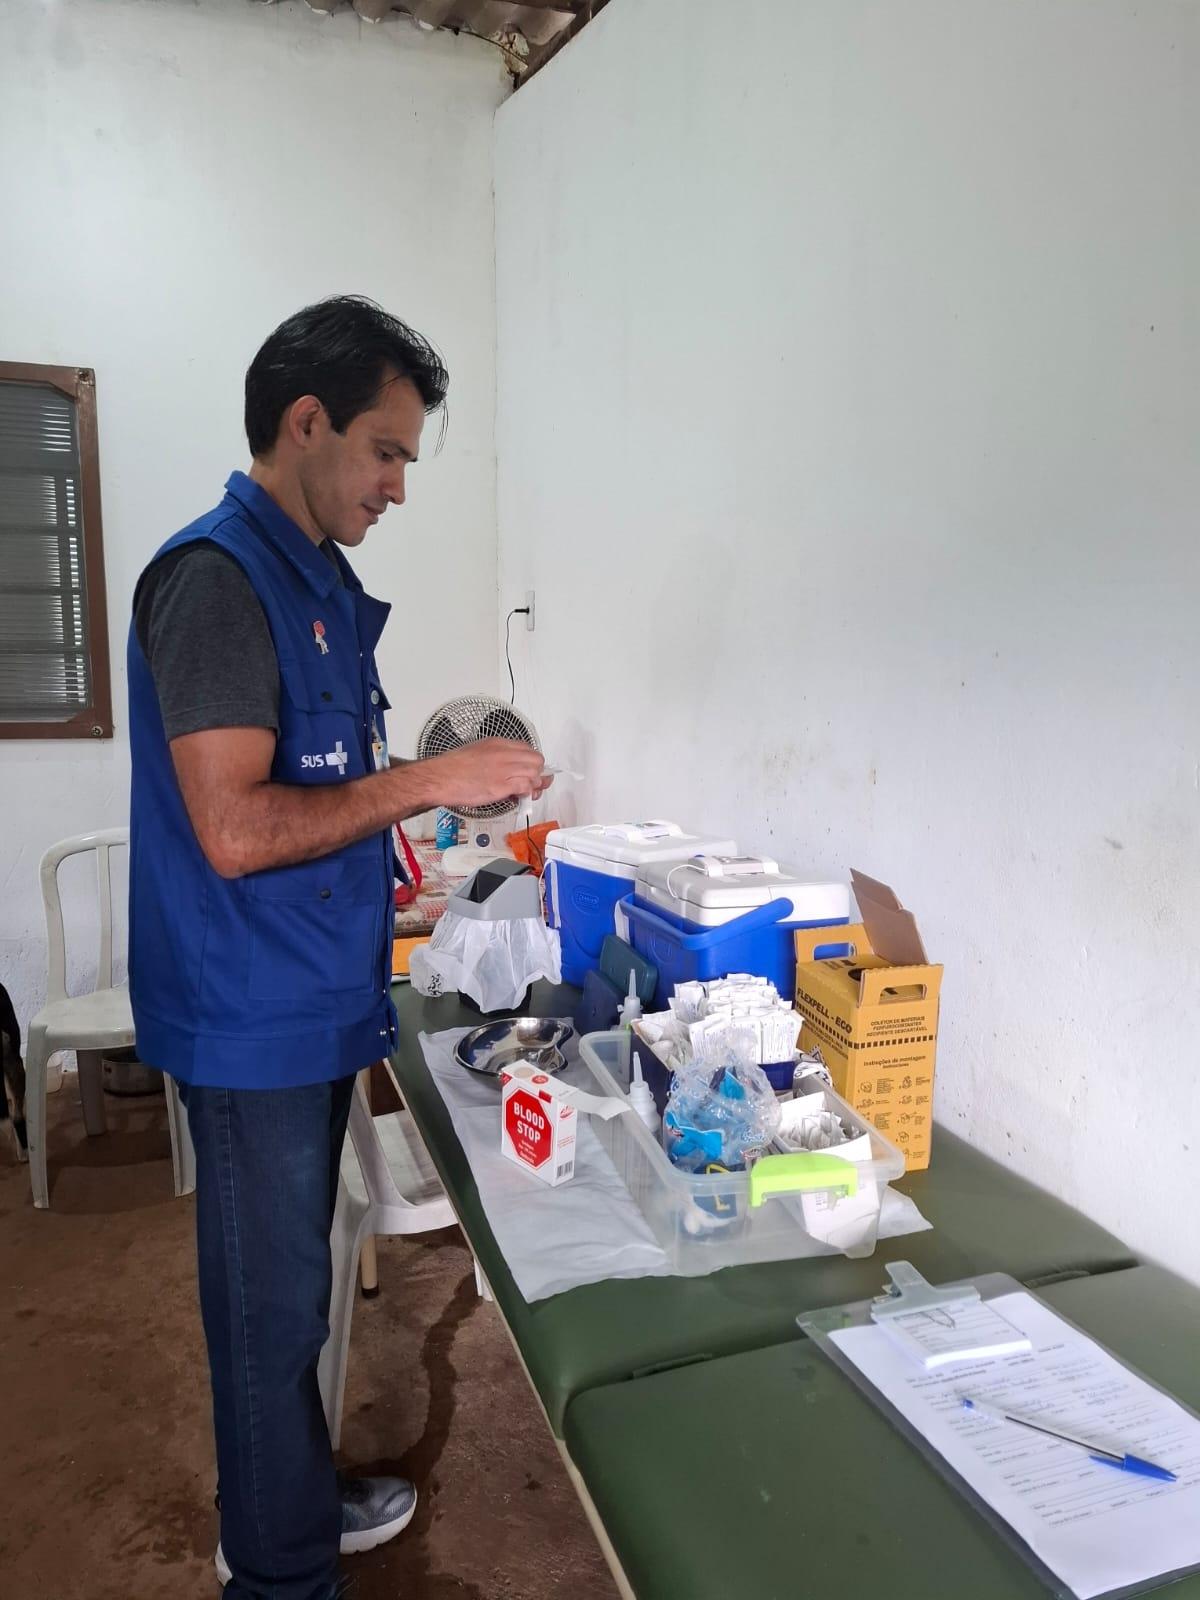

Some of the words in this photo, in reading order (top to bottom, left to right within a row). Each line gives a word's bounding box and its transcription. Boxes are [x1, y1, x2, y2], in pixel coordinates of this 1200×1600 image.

[301, 755, 324, 768] SUS
[797, 987, 830, 1019] FLEXPELL
[835, 1015, 853, 1034] ECO
[863, 1058, 891, 1067] Instruções
[513, 1101, 545, 1130] BLOOD
[517, 1120, 541, 1143] STOP
